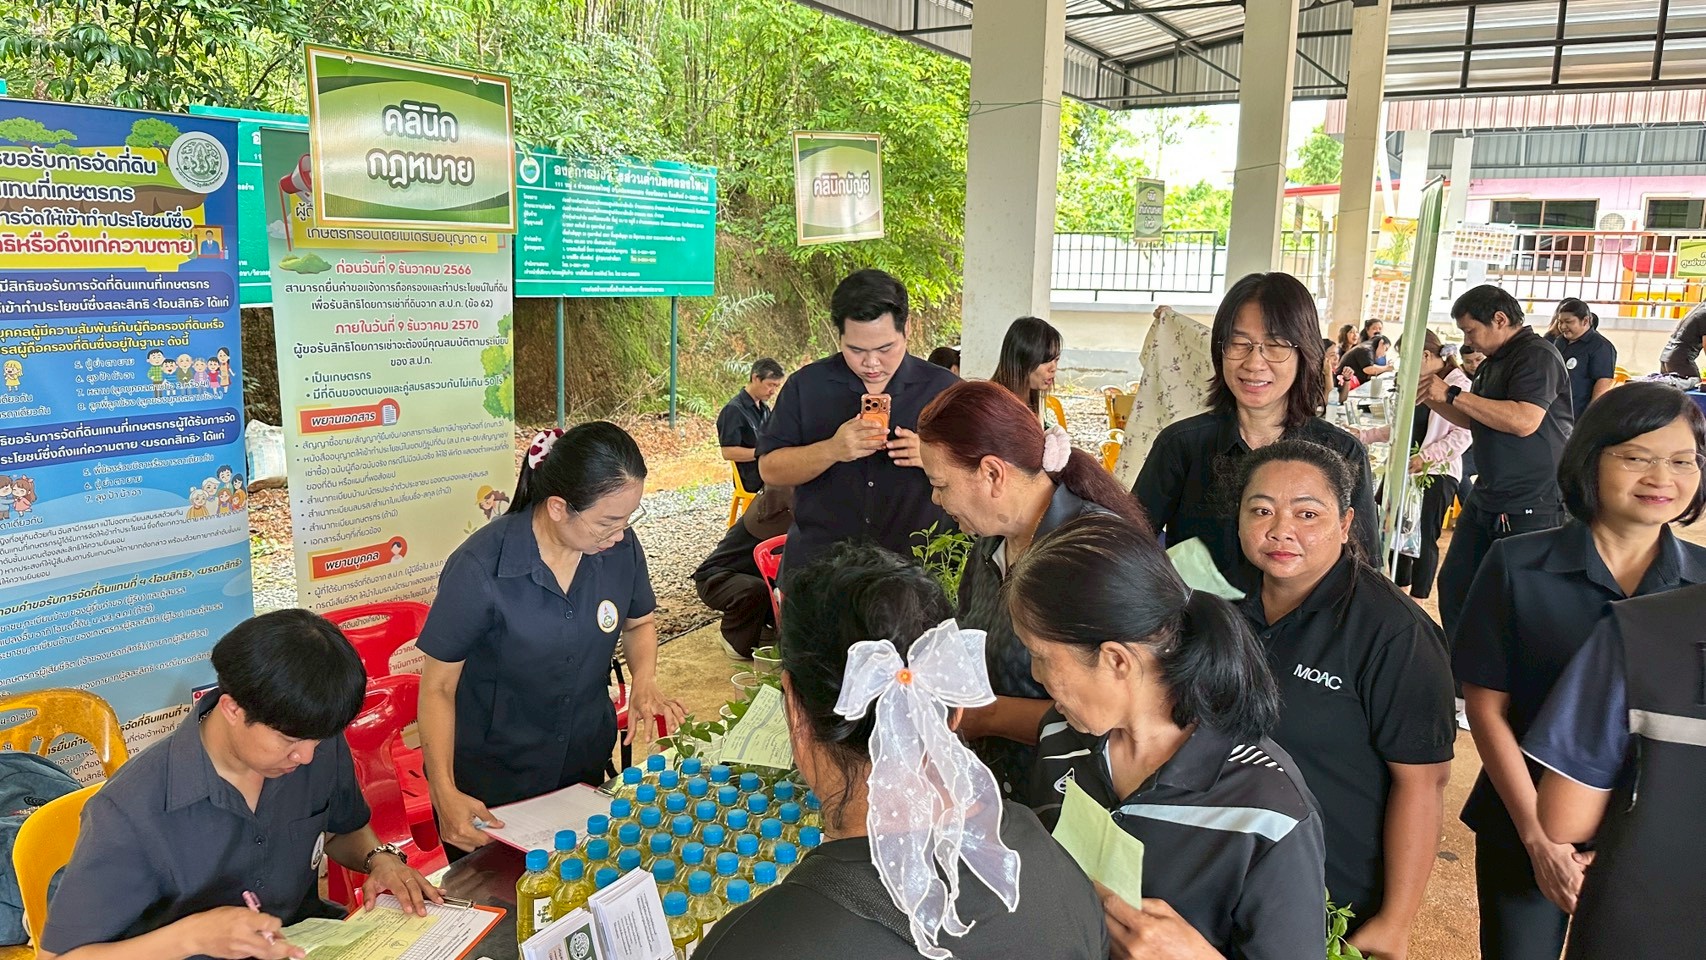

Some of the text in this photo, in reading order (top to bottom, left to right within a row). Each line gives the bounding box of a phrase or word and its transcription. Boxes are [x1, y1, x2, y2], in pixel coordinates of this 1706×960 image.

[384, 102, 456, 140] คลินิก
[0, 147, 156, 174] ขอรับการจัดที่ดิน
[368, 151, 474, 187] กฎหมาย
[814, 170, 870, 198] คลินิกบัญชี
[335, 255, 472, 275] ก่อนวันที่ 9 ธันวาคม 2566
[285, 277, 508, 293] สามารถยื่นคำขอแจ้งการถือครองและทำประโยชน์ในที่ดิน
[206, 295, 229, 308] ได้แก่
[480, 299, 493, 308] 62)
[335, 314, 479, 334] ภายในวันที่ 9 ธันวาคม 2570
[167, 331, 190, 346] ดังนี้
[390, 357, 407, 367] ของ
[311, 371, 372, 384] เป็นเกษตรกร
[484, 376, 495, 386] 50
[311, 411, 376, 427] พยานเอกสาร
[202, 429, 225, 442] ได้แก่
[325, 551, 380, 572] พยานบุคคล
[1293, 663, 1343, 690] MOAC
